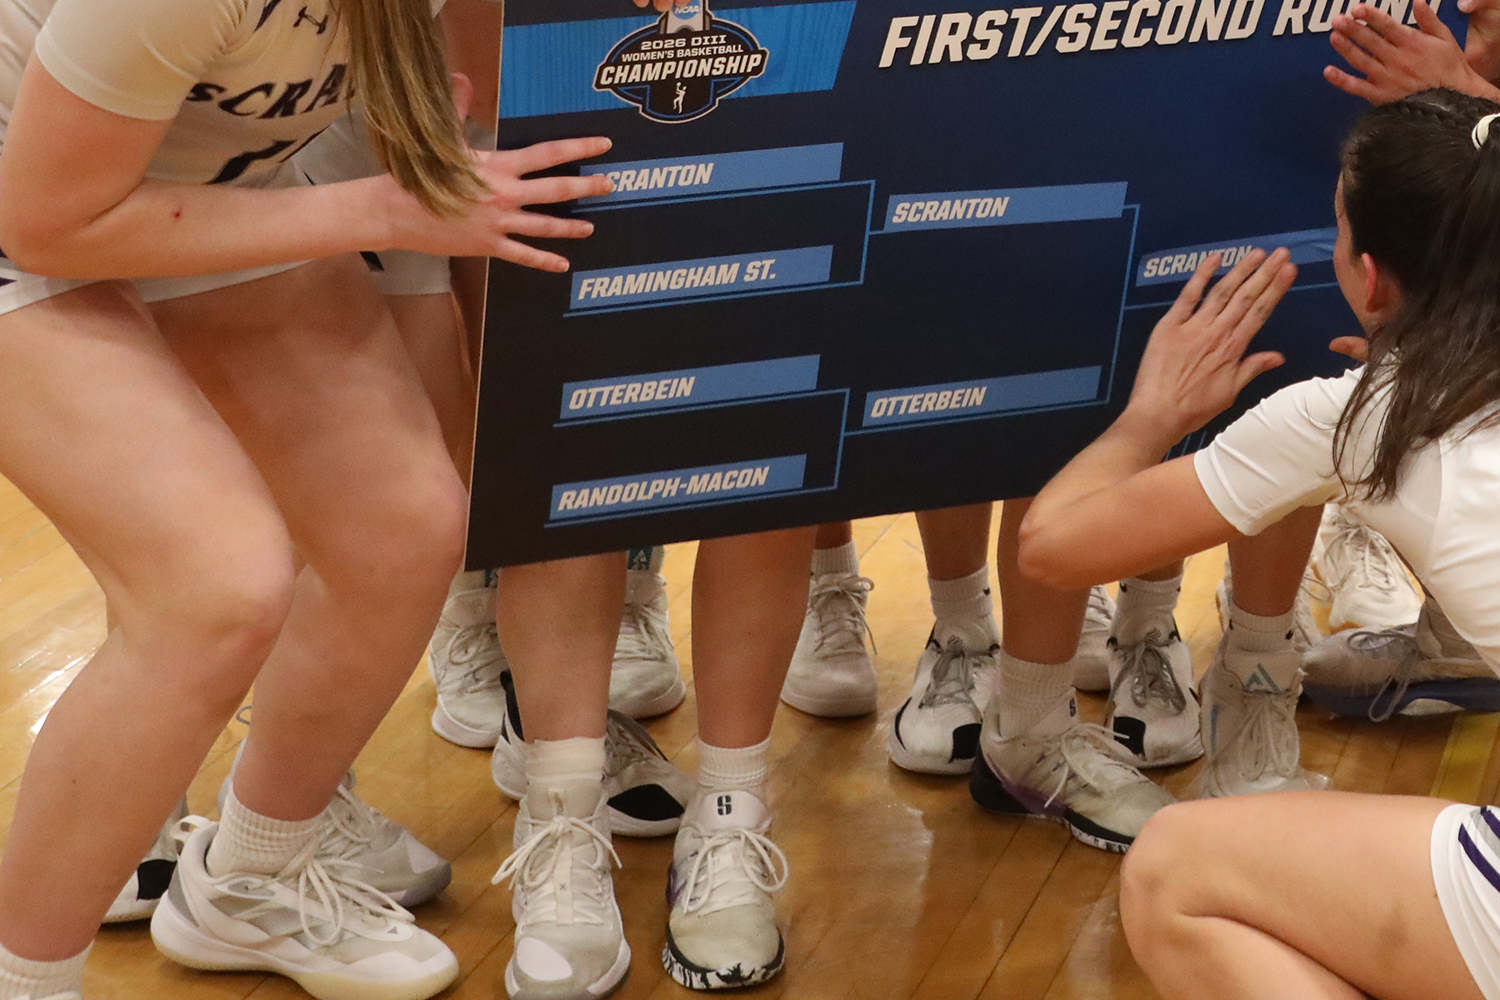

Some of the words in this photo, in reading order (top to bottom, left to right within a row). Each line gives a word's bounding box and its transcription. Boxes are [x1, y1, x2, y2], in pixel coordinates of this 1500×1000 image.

[674, 4, 700, 15] NCAA
[621, 49, 676, 63] WOMEN'S
[676, 44, 744, 59] BASKETBALL
[640, 38, 687, 51] 2026
[691, 34, 727, 47] DIII
[600, 53, 763, 86] CHAMPIONSHIP
[591, 162, 714, 193] CRANTON
[892, 196, 1010, 225] SCRANTON
[577, 262, 739, 301] FRAMINGHAM
[743, 258, 778, 284] ST.
[568, 376, 696, 411] OTTERBEIN
[870, 386, 987, 419] OTTERBEIN
[557, 465, 770, 512] RANDOLPH-MACON
